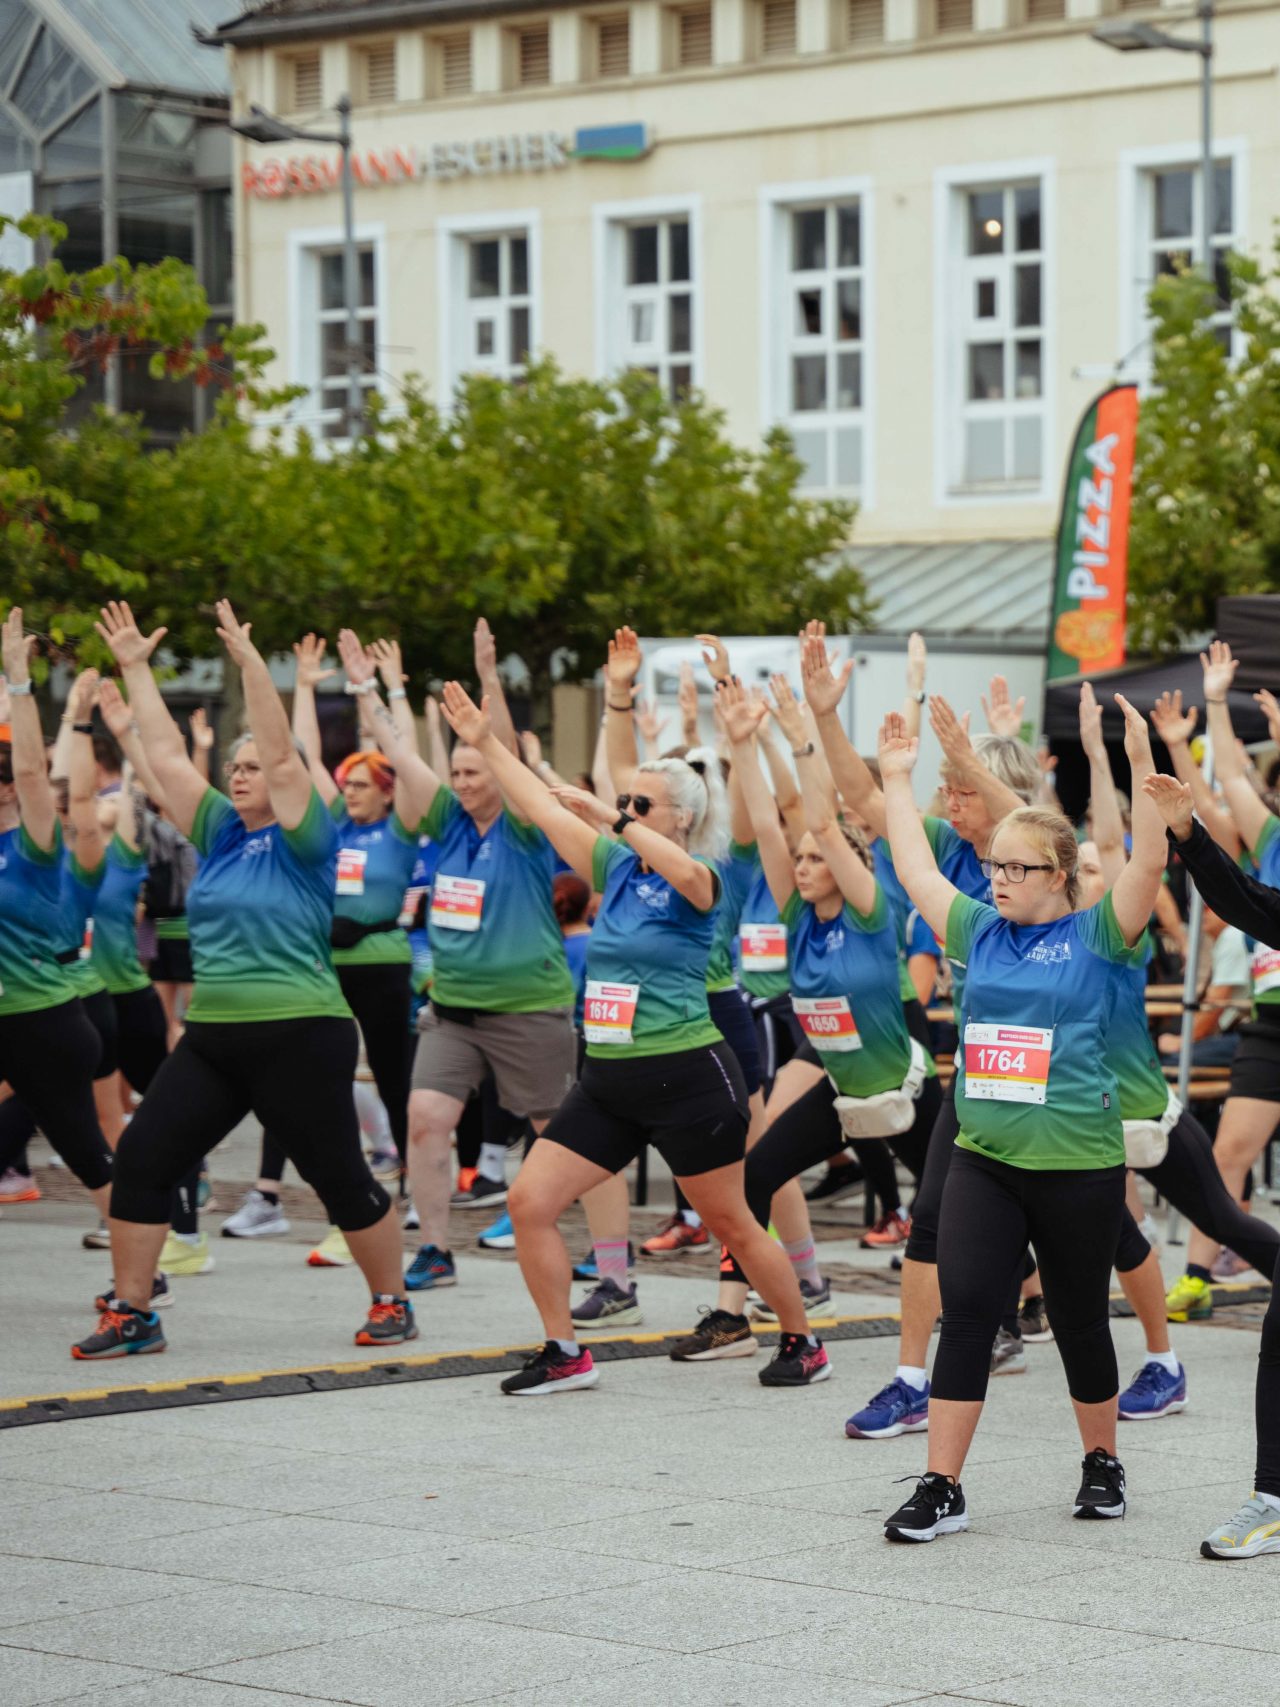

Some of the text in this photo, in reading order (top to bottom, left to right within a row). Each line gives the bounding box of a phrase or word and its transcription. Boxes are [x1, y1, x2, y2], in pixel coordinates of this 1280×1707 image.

[1067, 432, 1120, 600] PIZZA
[590, 1001, 619, 1021] 1614
[806, 1015, 840, 1032] 1650
[978, 1048, 1027, 1073] 1764
